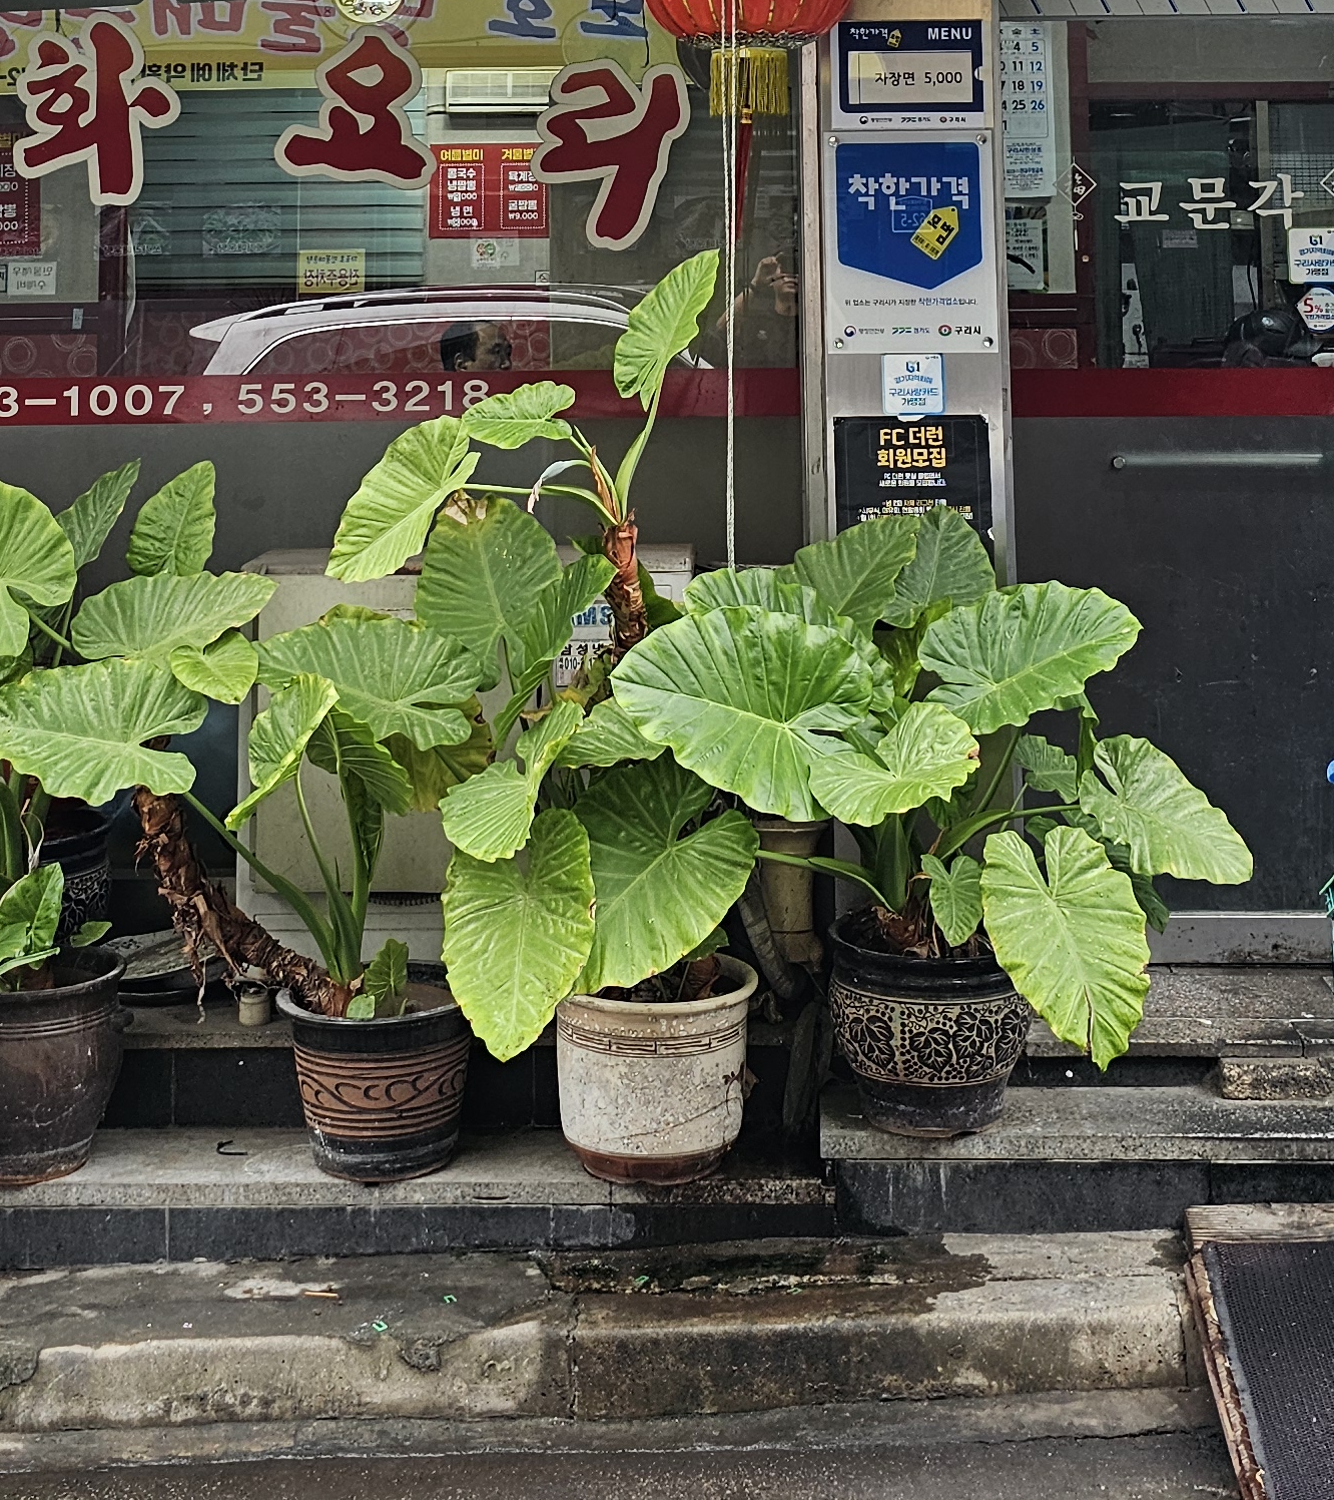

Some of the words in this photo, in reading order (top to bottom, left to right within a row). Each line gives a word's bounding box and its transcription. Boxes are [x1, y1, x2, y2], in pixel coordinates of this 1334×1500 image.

[850, 27, 888, 39] 착한가격
[928, 27, 972, 40] MENU
[1031, 41, 1039, 51] 5
[1012, 61, 1023, 71] 11
[1030, 61, 1043, 71] 12
[875, 72, 915, 86] 자장면
[924, 71, 962, 86] 5,000
[1012, 80, 1025, 91] 18
[1030, 80, 1043, 91] 19
[1011, 100, 1026, 110] 25
[1030, 100, 1045, 110] 26
[848, 173, 969, 210] 착한가격
[1114, 173, 1305, 229] 교문각
[954, 325, 981, 336] 구리시
[879, 428, 905, 446] FC
[909, 426, 943, 446] 더런
[876, 447, 947, 468] 회원모집
